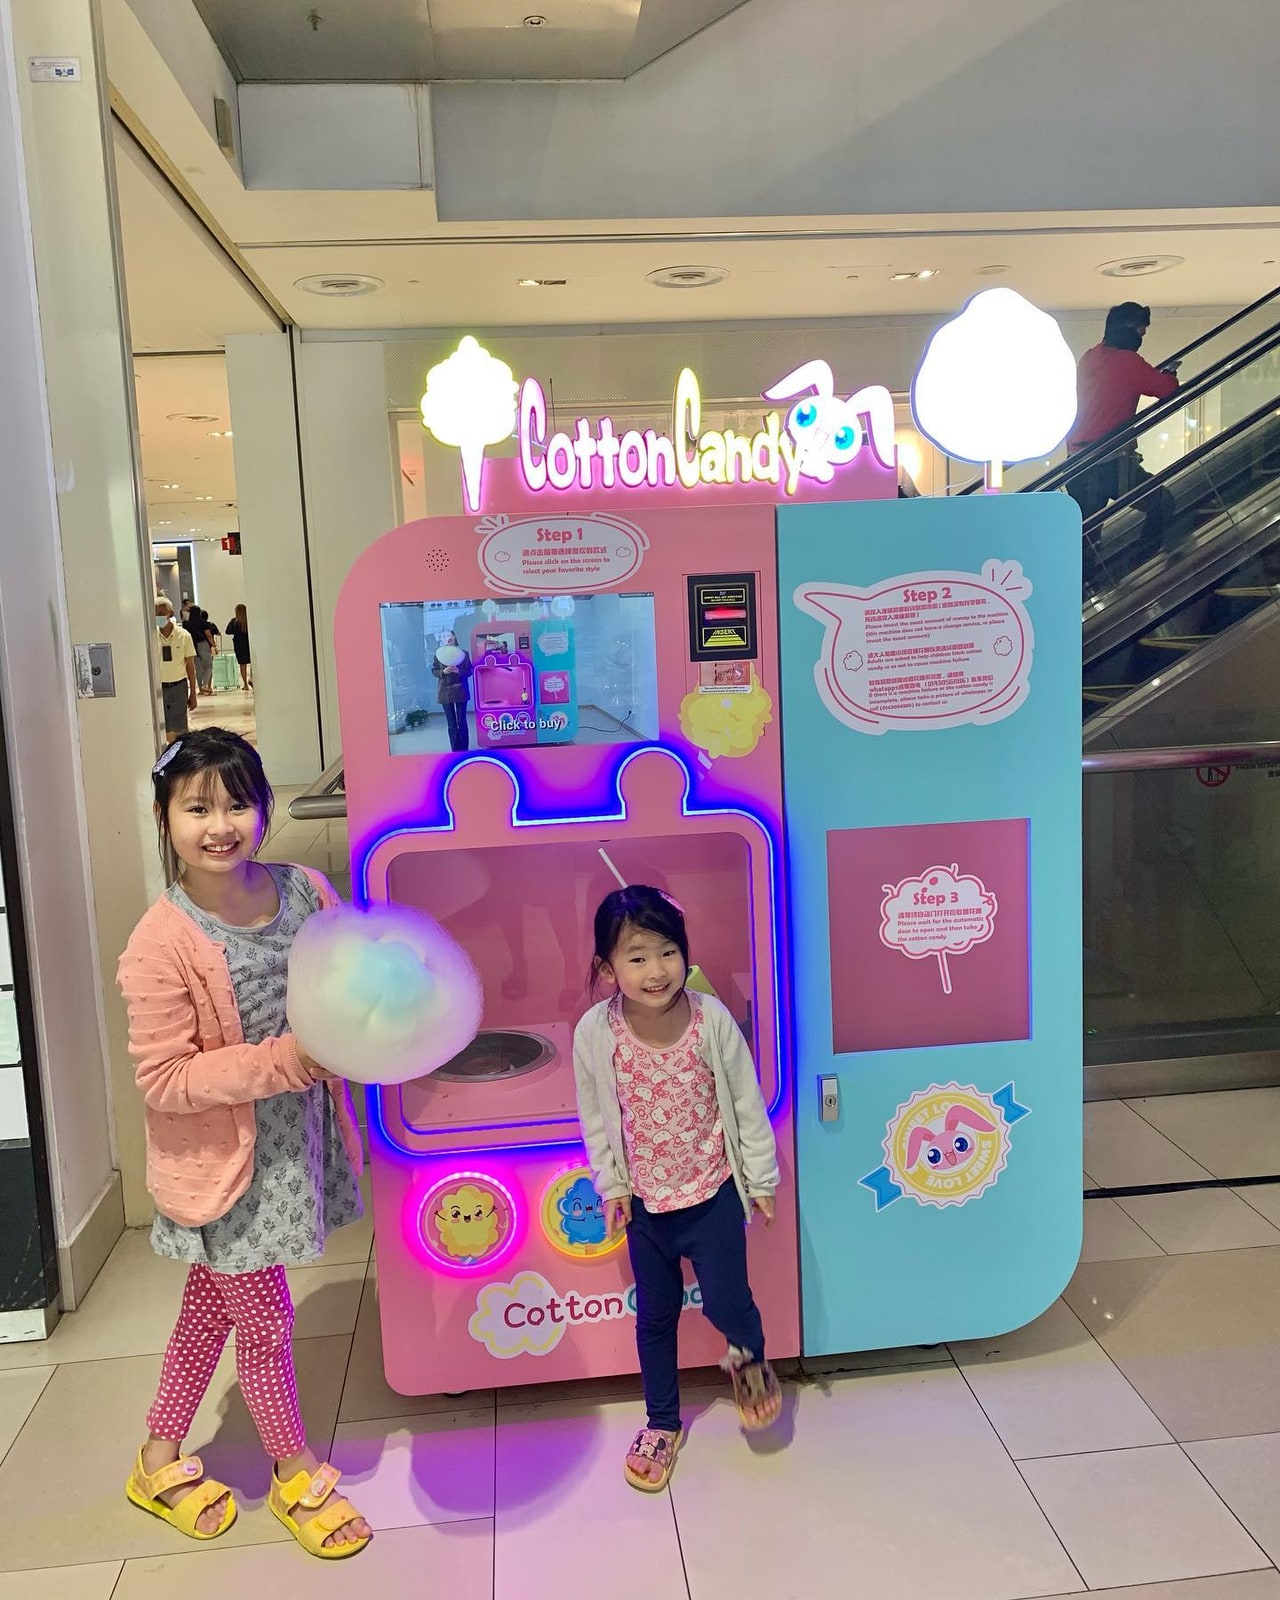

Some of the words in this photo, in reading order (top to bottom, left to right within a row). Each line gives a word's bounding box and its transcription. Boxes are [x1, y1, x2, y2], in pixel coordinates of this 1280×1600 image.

[536, 528, 572, 544] Step
[576, 528, 583, 540] 1
[903, 588, 938, 603] Step
[942, 587, 952, 598] 2
[490, 720, 520, 731] Click
[524, 720, 536, 729] to
[540, 718, 561, 731] buy
[913, 892, 946, 906] Step
[950, 892, 959, 903] 3
[965, 1140, 992, 1182] SWEET
[926, 1172, 963, 1190] LOVE
